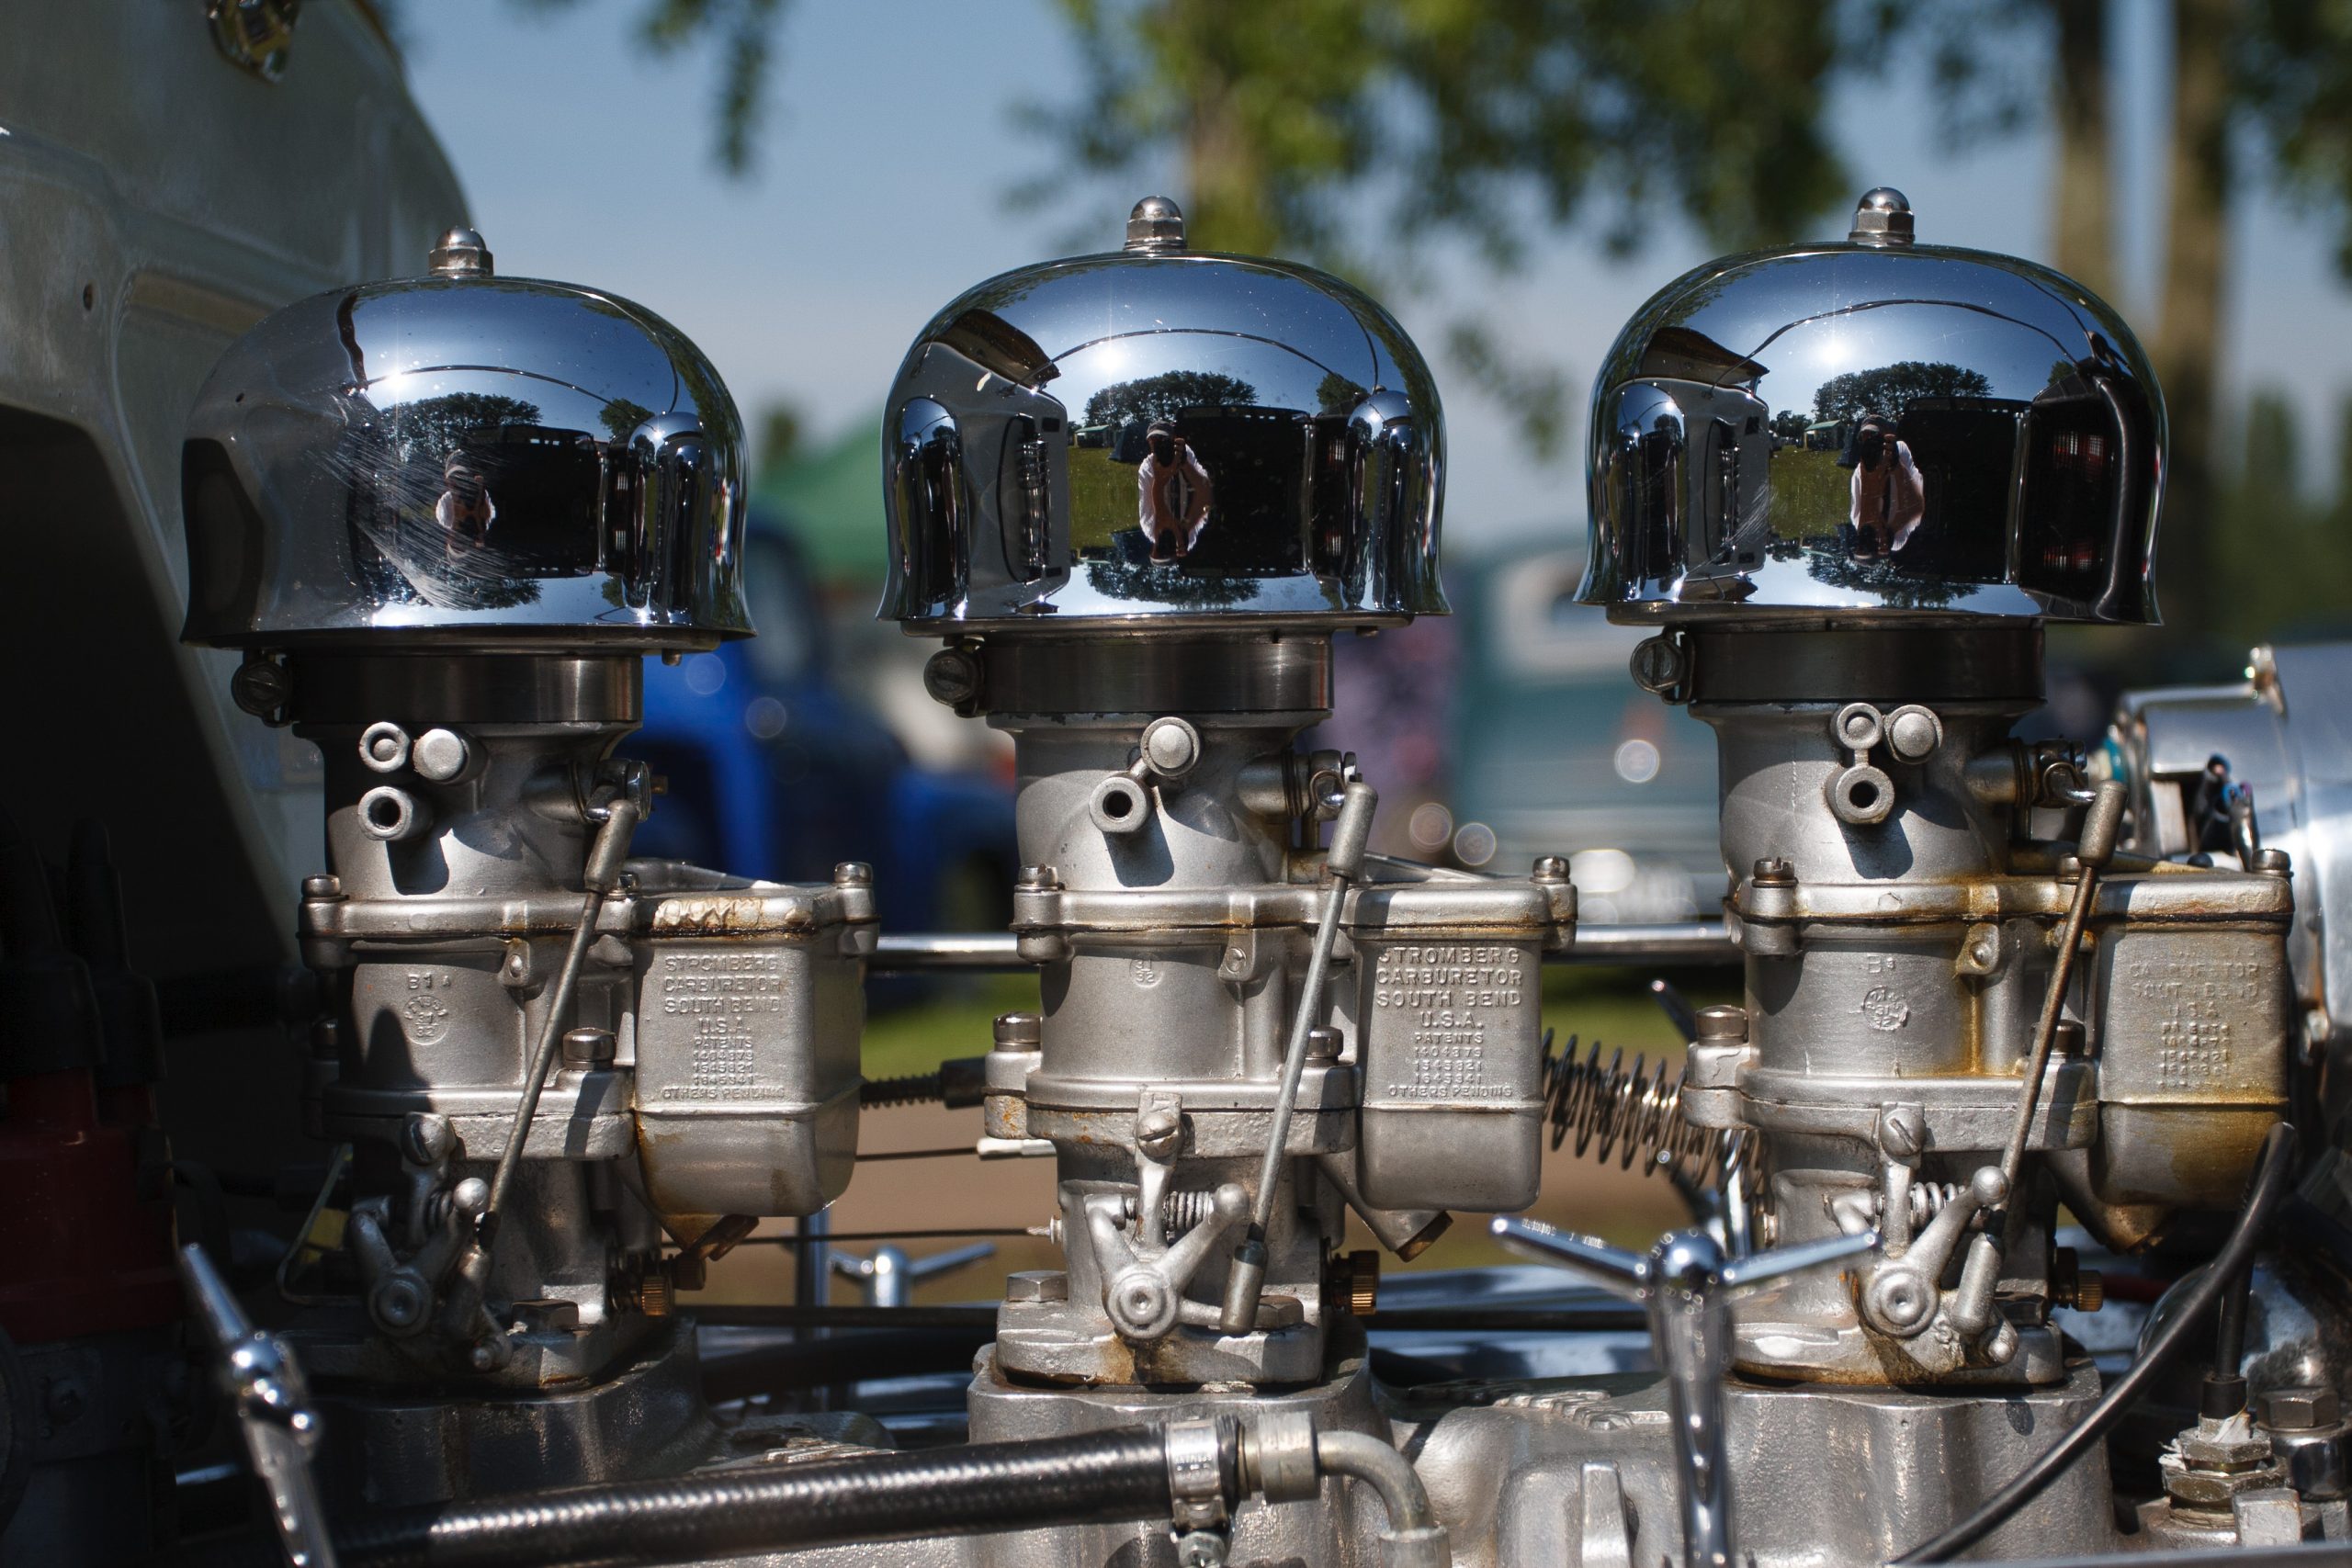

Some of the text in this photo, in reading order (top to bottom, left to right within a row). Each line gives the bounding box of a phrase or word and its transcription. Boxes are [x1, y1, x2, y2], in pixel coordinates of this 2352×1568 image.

[1378, 947, 1520, 964] STROMBERG
[664, 976, 781, 993] CARBURETOR
[1376, 967, 1523, 986] CARBURETOR
[664, 997, 725, 1014] SOUTH
[1376, 990, 1521, 1008] SOUTH BEND
[698, 1017, 752, 1035] U.S.A.
[1420, 1010, 1485, 1029] U.S.A.
[694, 1036, 754, 1049] PATENTS
[1415, 1032, 1484, 1044] PATENTS
[662, 1086, 718, 1100] OTHERS
[1388, 1084, 1514, 1098] OTHERS PENDING
